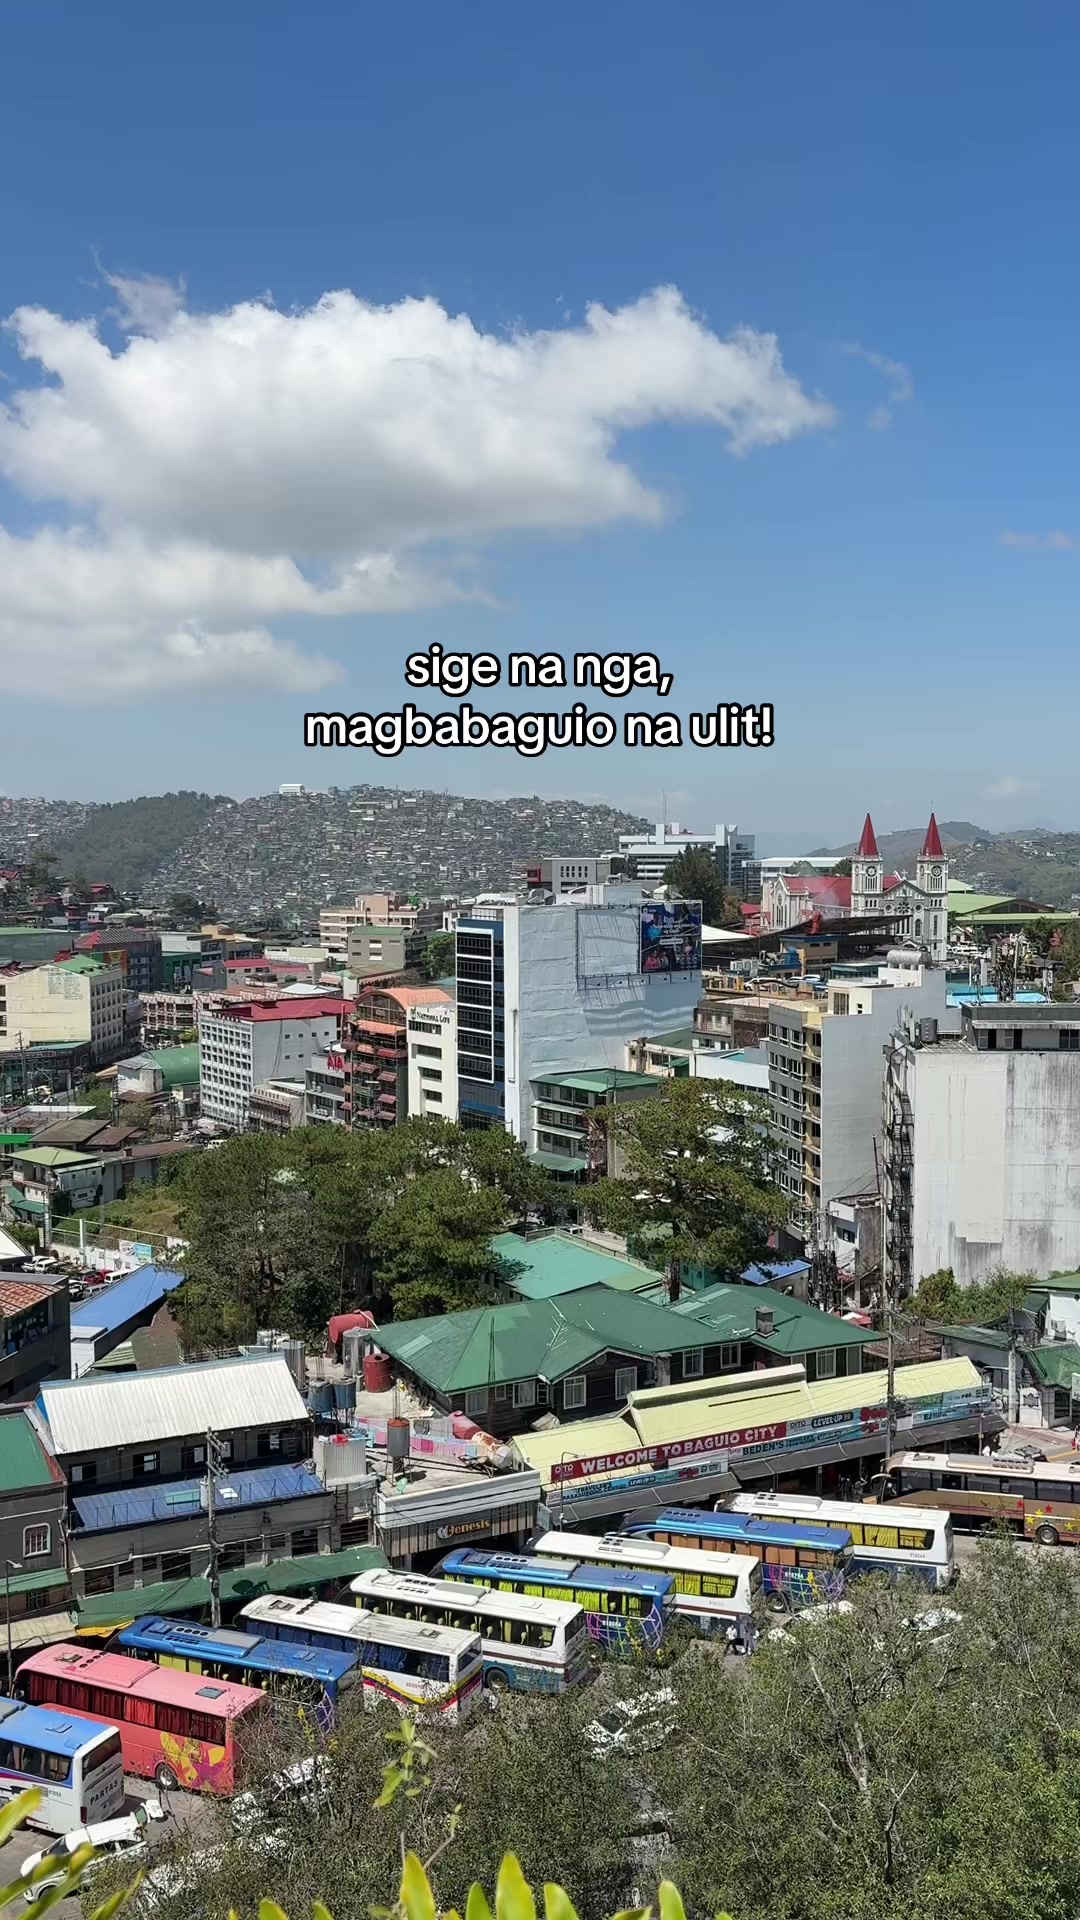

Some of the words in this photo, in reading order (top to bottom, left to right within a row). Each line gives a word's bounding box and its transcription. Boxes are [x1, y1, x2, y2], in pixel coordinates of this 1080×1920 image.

[327, 1055, 345, 1072] AIA
[554, 1464, 574, 1475] DTO
[580, 1449, 658, 1474] WELCOME
[662, 1444, 682, 1457] TO
[684, 1432, 741, 1452] BAGUIO
[744, 1425, 778, 1442] CITY
[743, 1441, 784, 1456] BEDEN'S
[444, 1519, 490, 1538] Genesis
[90, 1779, 119, 1805] PARTAS
